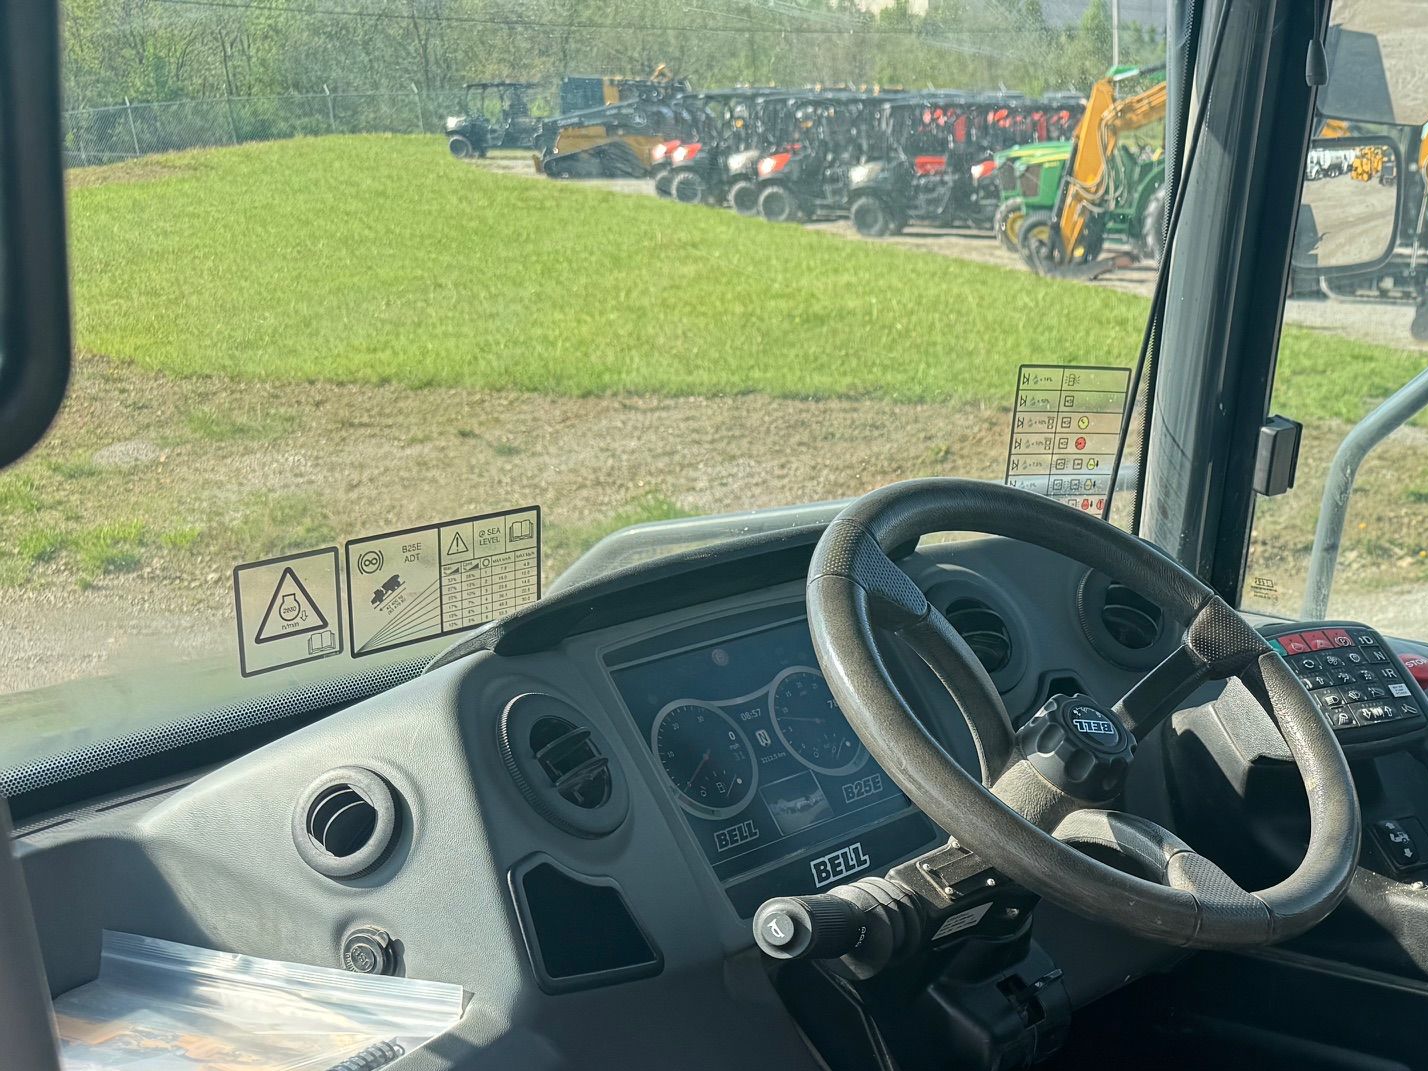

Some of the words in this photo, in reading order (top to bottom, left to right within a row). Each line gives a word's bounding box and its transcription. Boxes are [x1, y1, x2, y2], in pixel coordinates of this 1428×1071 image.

[487, 527, 501, 535] SEA
[480, 537, 500, 546] LEVEL
[402, 542, 422, 553] B25E
[404, 553, 421, 563] ADT
[1373, 651, 1386, 660] N
[1406, 659, 1428, 668] STOP
[741, 708, 761, 721] 08:57
[1073, 719, 1115, 734] BELL
[842, 773, 883, 803] B25E
[714, 820, 759, 852] BELL
[809, 842, 871, 888] BELL
